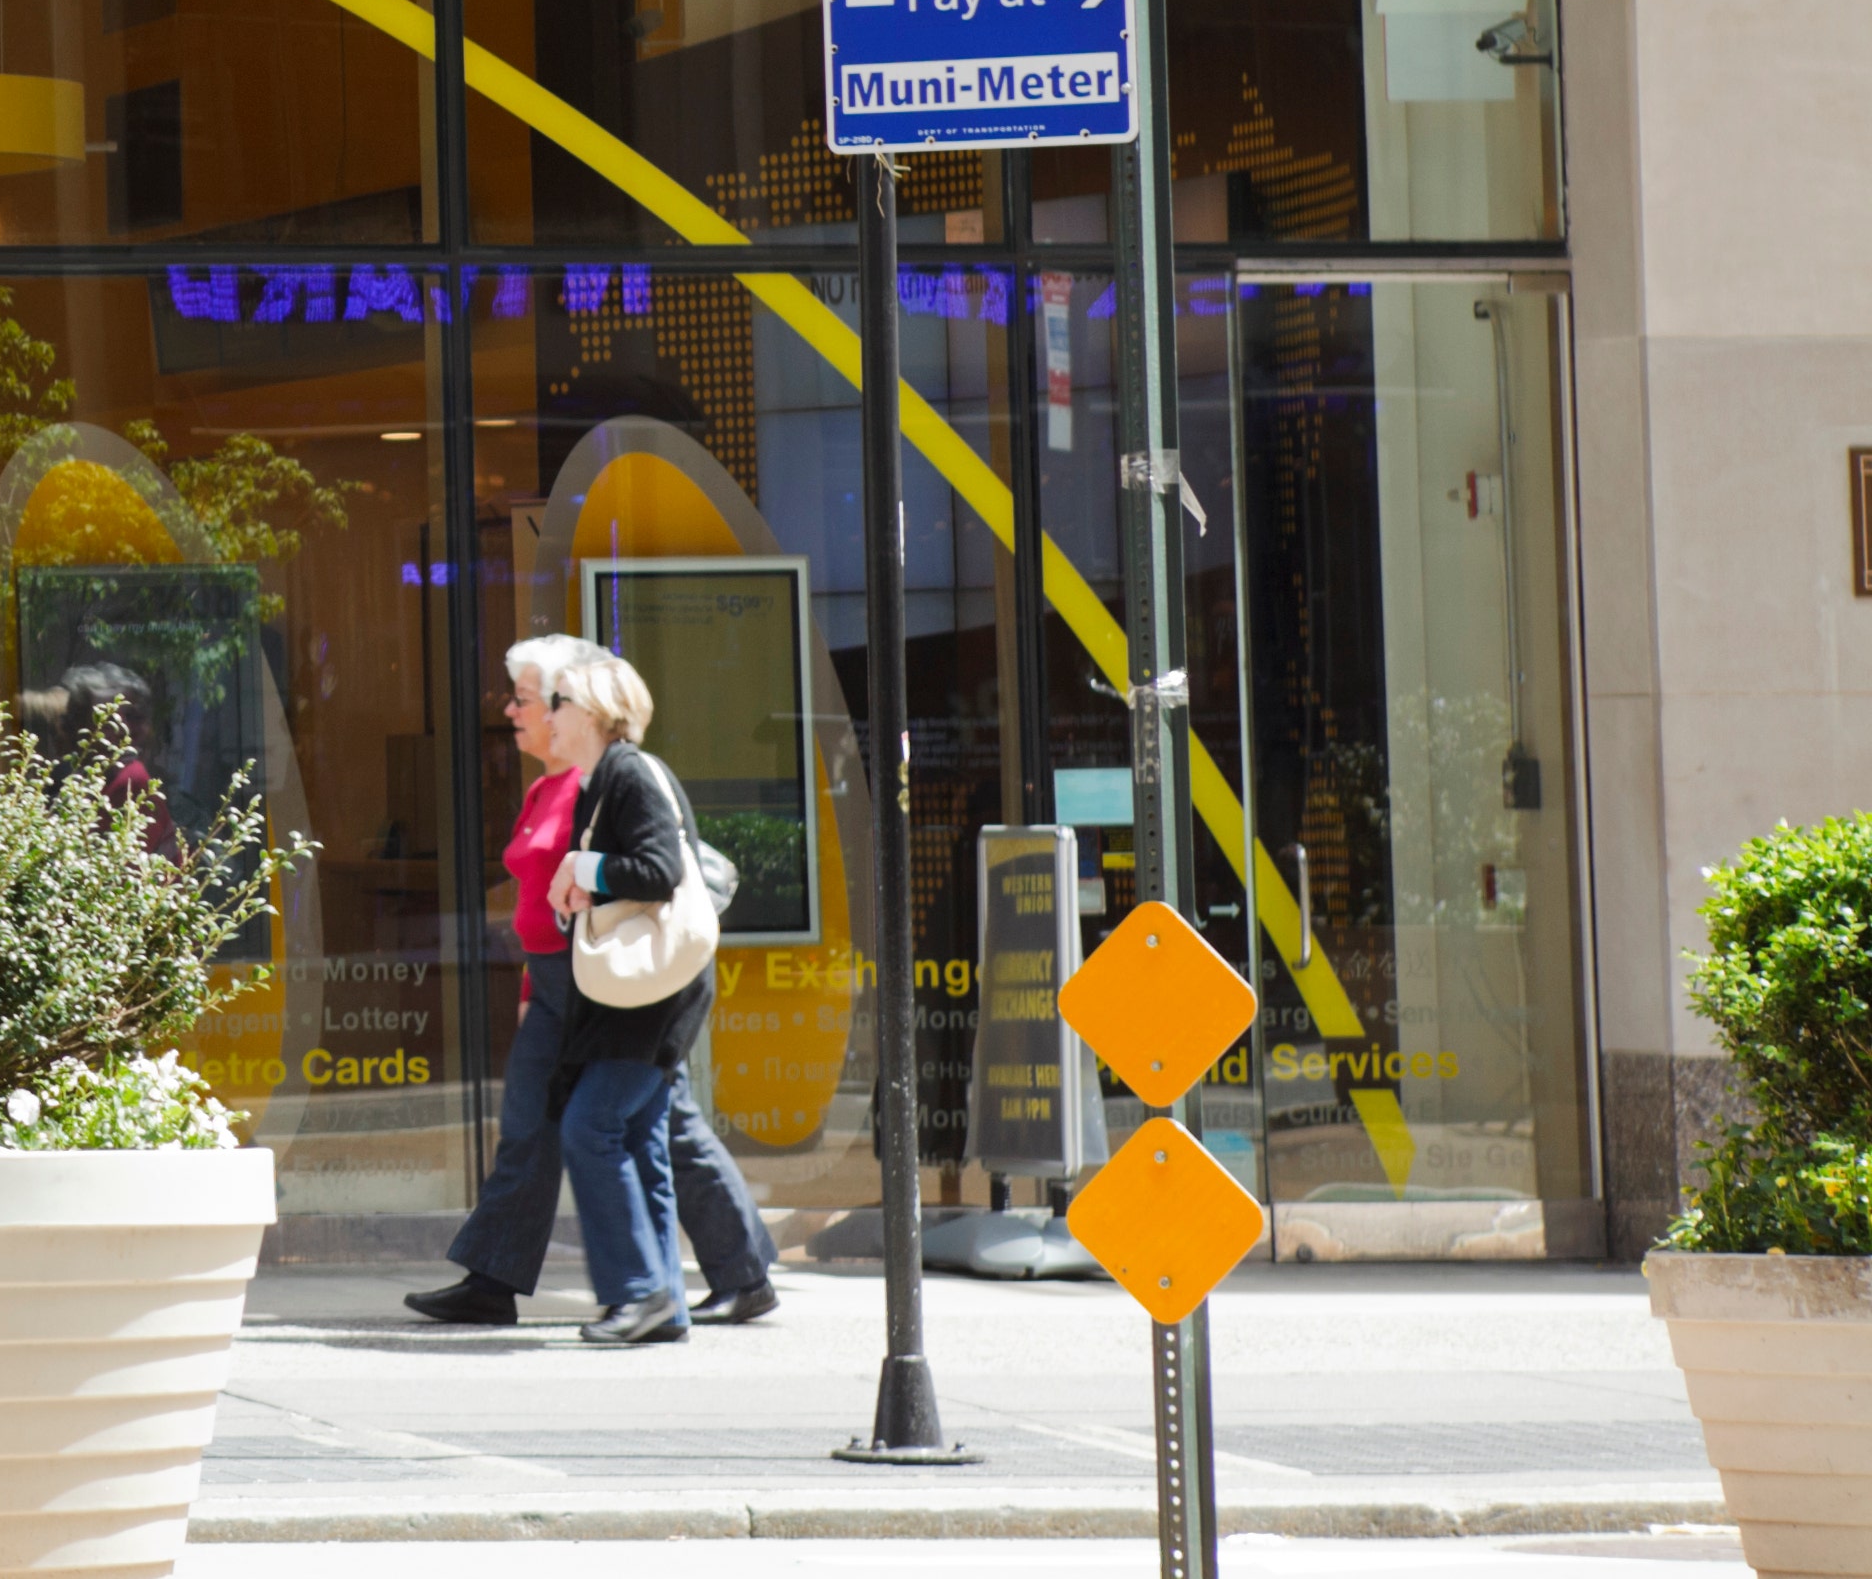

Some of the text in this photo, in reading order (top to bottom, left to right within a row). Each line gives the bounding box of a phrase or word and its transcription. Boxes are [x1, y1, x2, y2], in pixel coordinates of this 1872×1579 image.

[846, 64, 1114, 109] Muni-Meter
[322, 958, 429, 988] Money
[765, 951, 982, 997] Exchng
[324, 1005, 430, 1037] Lottery
[302, 1047, 431, 1086] Cards
[1270, 1043, 1461, 1082] Services
[714, 1105, 782, 1136] gent
